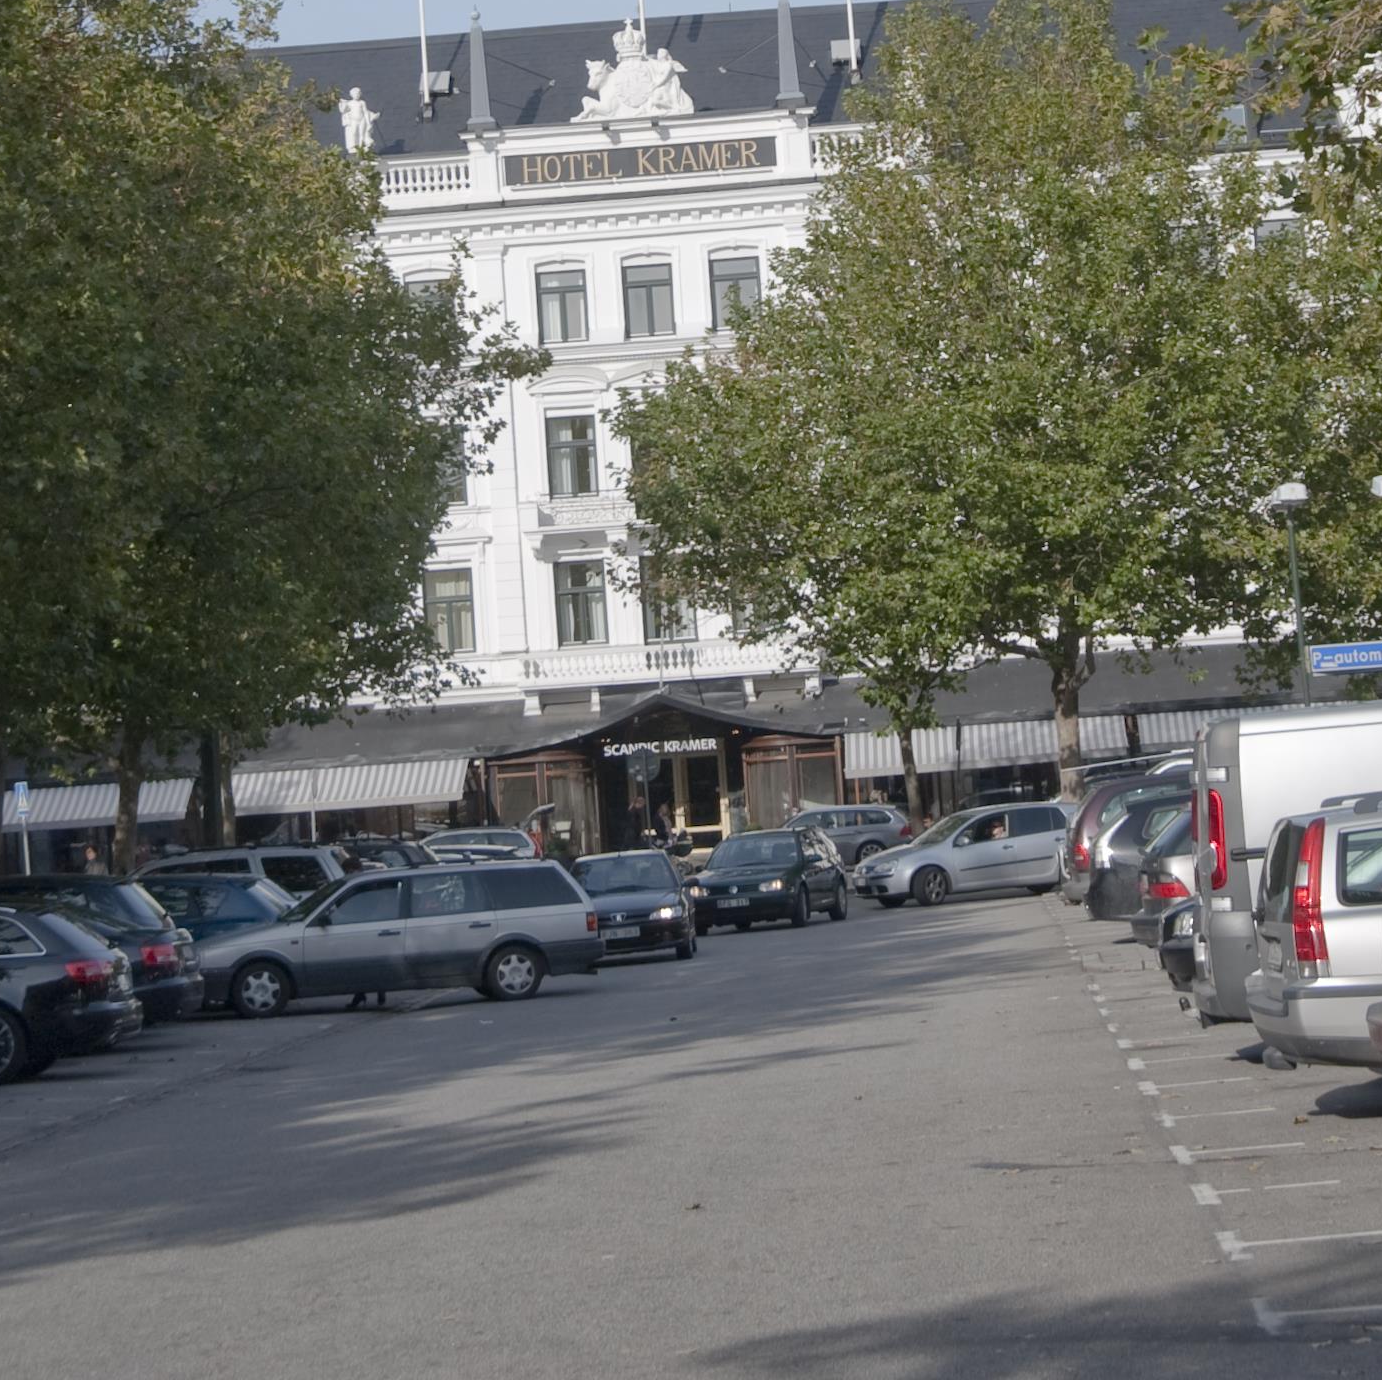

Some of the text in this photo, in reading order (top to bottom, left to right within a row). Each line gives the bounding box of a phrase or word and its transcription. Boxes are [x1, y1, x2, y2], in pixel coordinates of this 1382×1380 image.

[521, 140, 761, 184] HOTEL KRAMER
[664, 738, 717, 753] KRAMER
